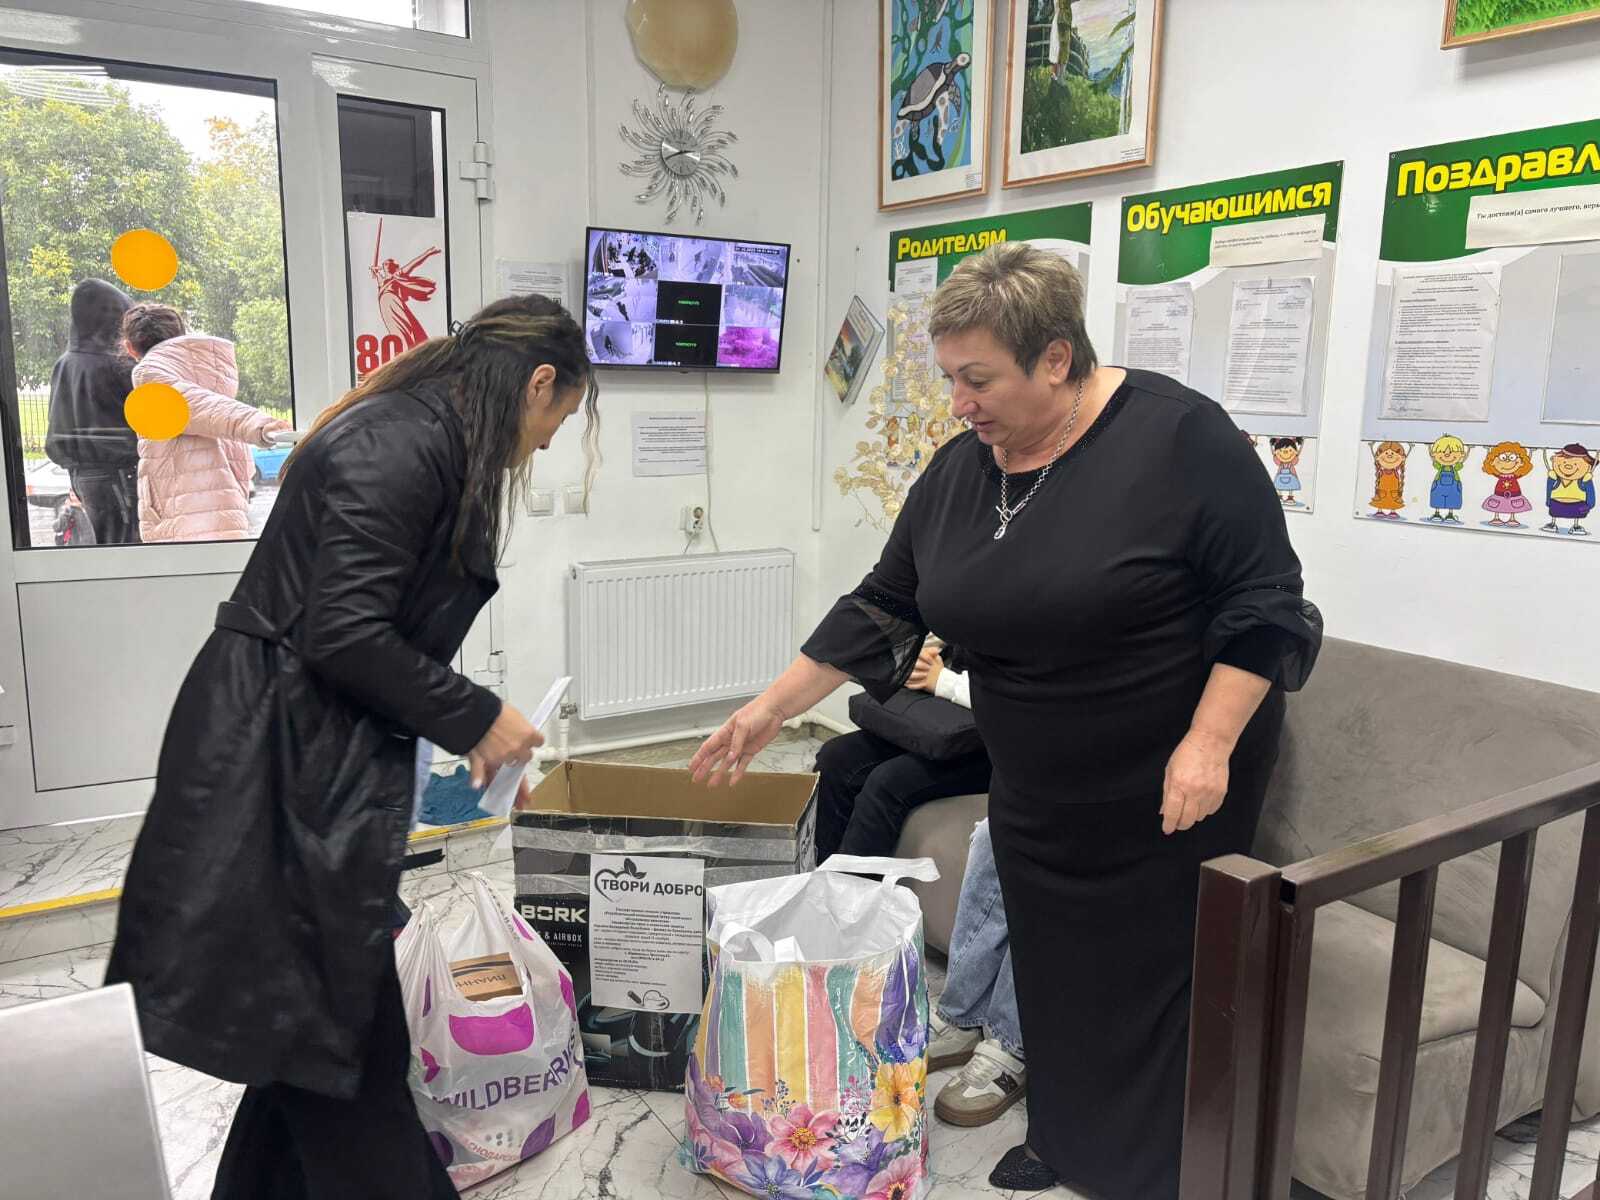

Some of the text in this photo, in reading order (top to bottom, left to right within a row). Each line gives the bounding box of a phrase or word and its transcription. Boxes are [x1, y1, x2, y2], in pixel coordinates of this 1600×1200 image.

[1126, 181, 1332, 235] Обучающимся
[898, 229, 1007, 260] Родителям
[601, 879, 703, 897] ТВОРИ ДОБРО
[521, 904, 588, 924] BORK
[553, 932, 583, 943] AIRBOX
